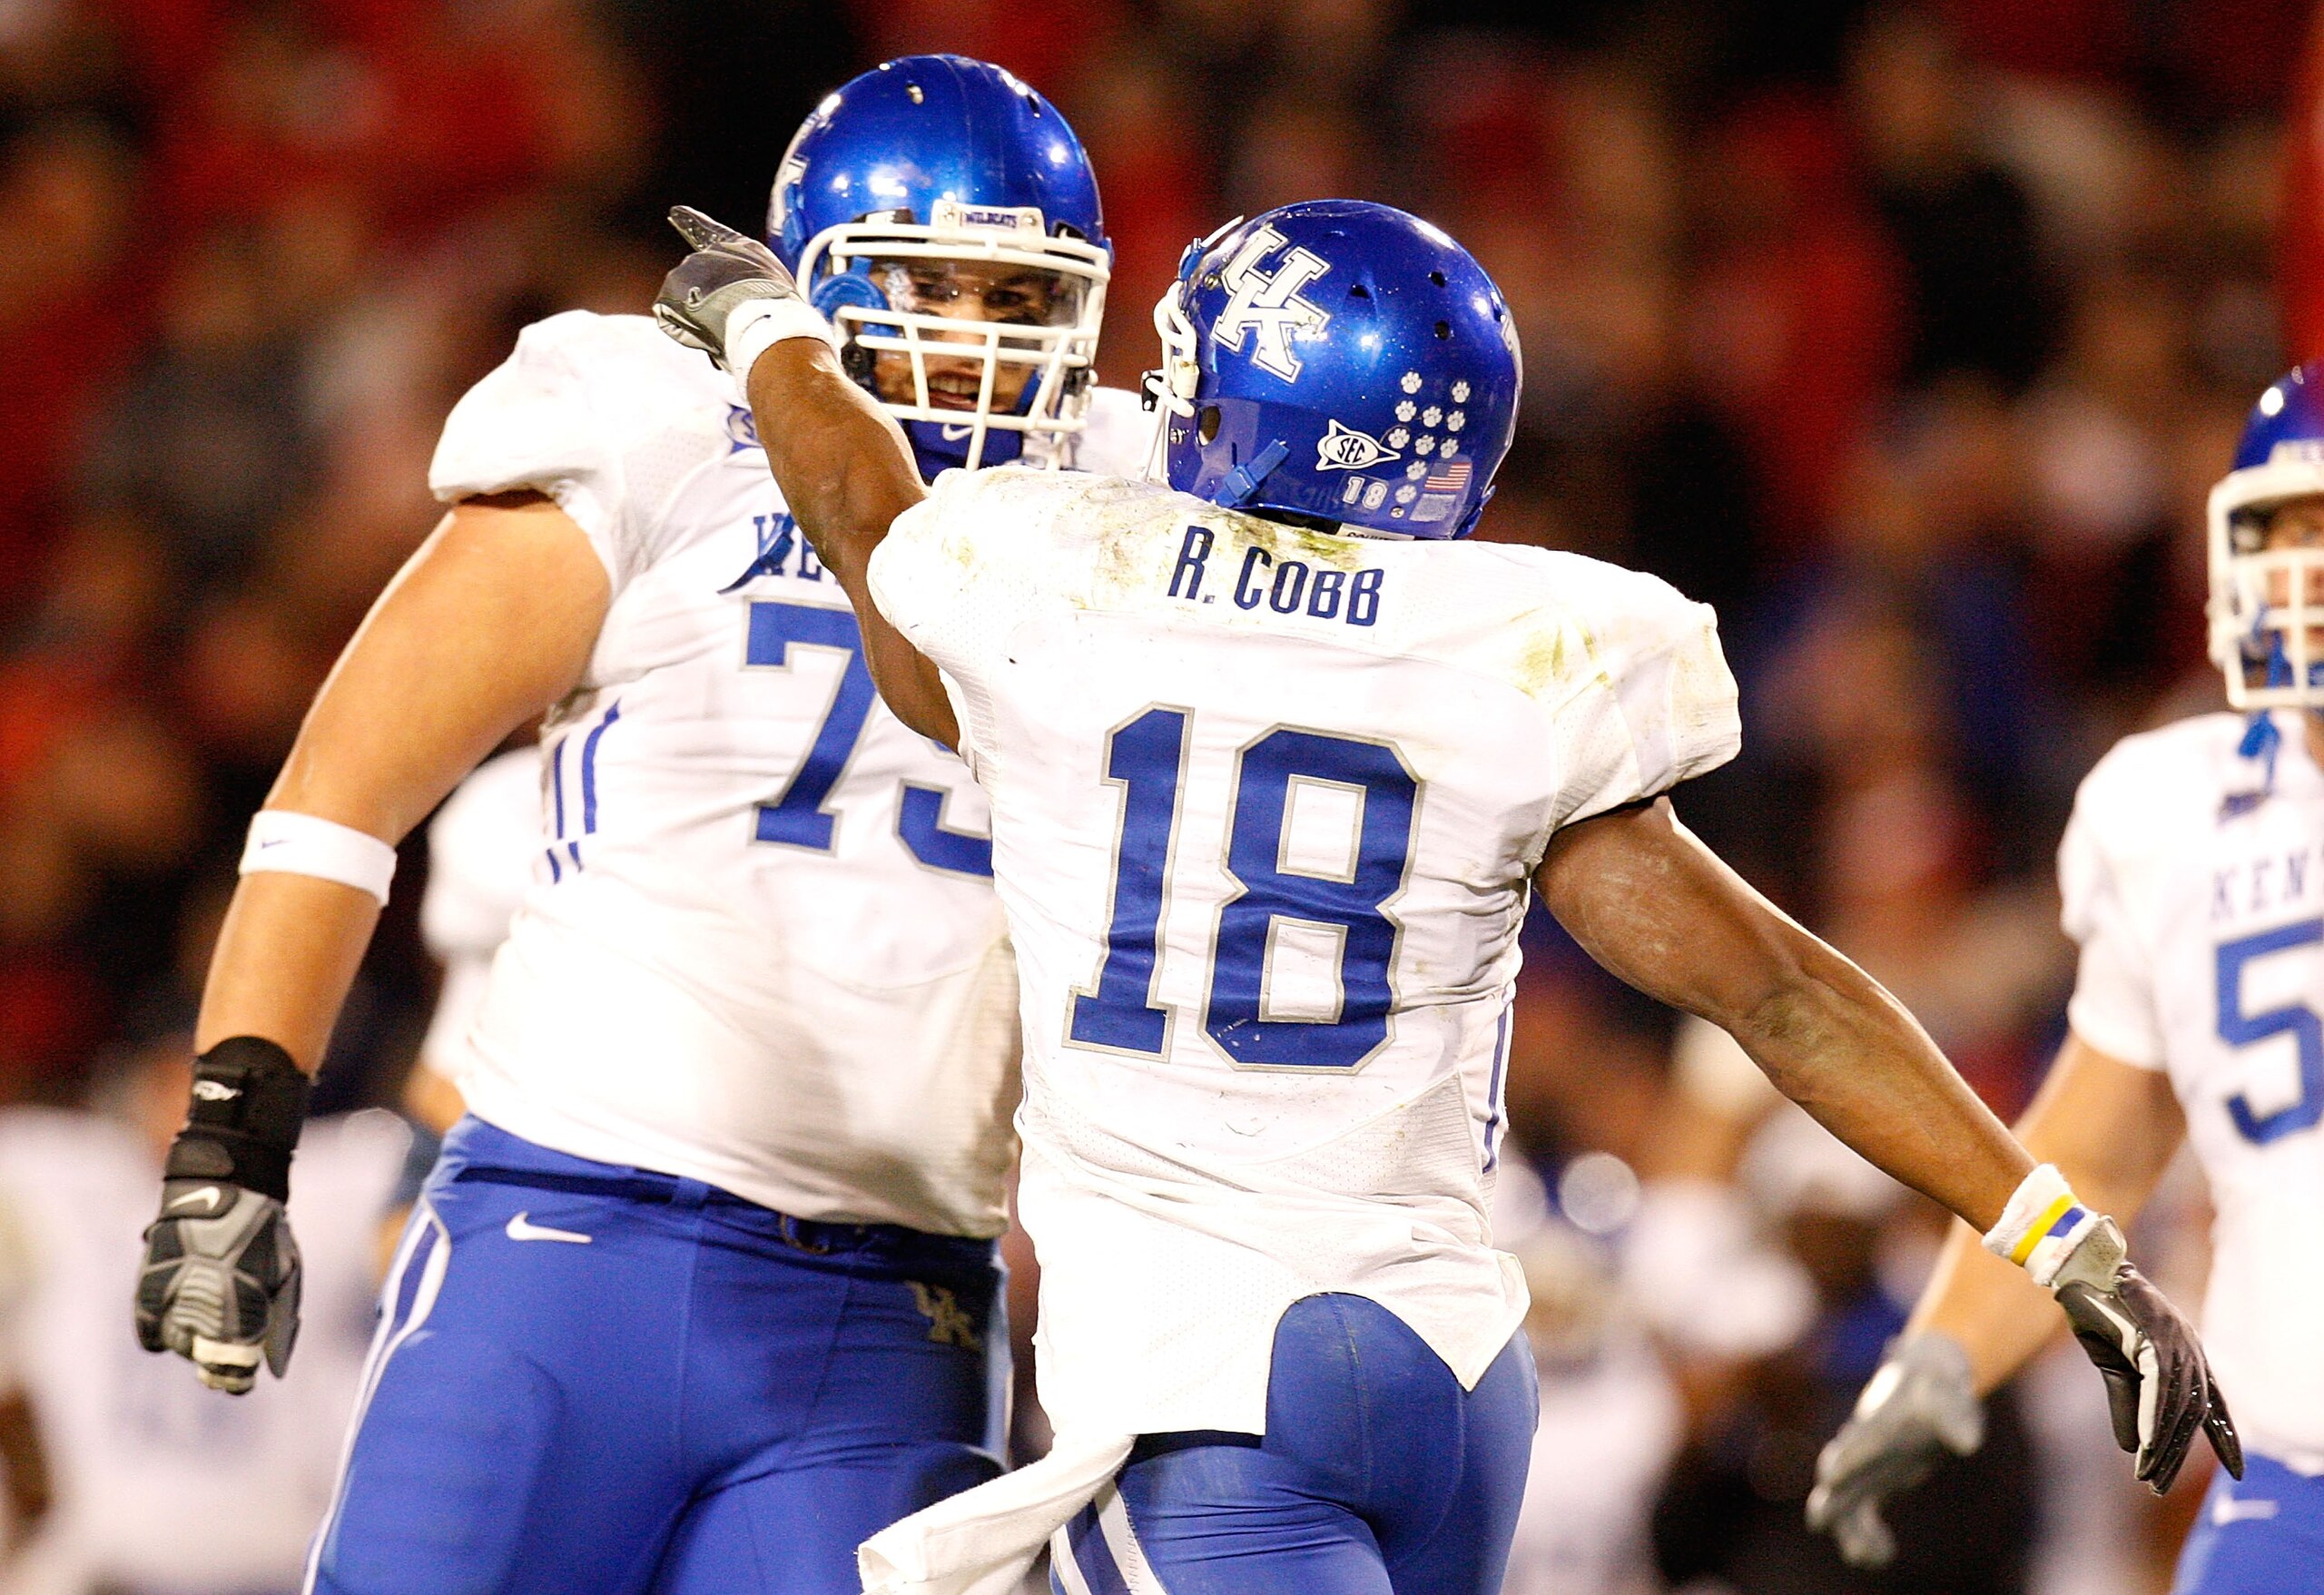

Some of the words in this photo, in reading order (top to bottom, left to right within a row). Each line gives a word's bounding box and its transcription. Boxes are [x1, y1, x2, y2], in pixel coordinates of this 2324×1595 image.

[1211, 224, 1332, 385] UK
[1336, 437, 1366, 464] SEC
[1342, 475, 1389, 511] 18
[753, 512, 840, 585] KE
[1167, 525, 1216, 605] R.
[1233, 546, 1385, 627] COBB
[1061, 700, 1427, 1076] 18
[2211, 847, 2324, 922] KEN
